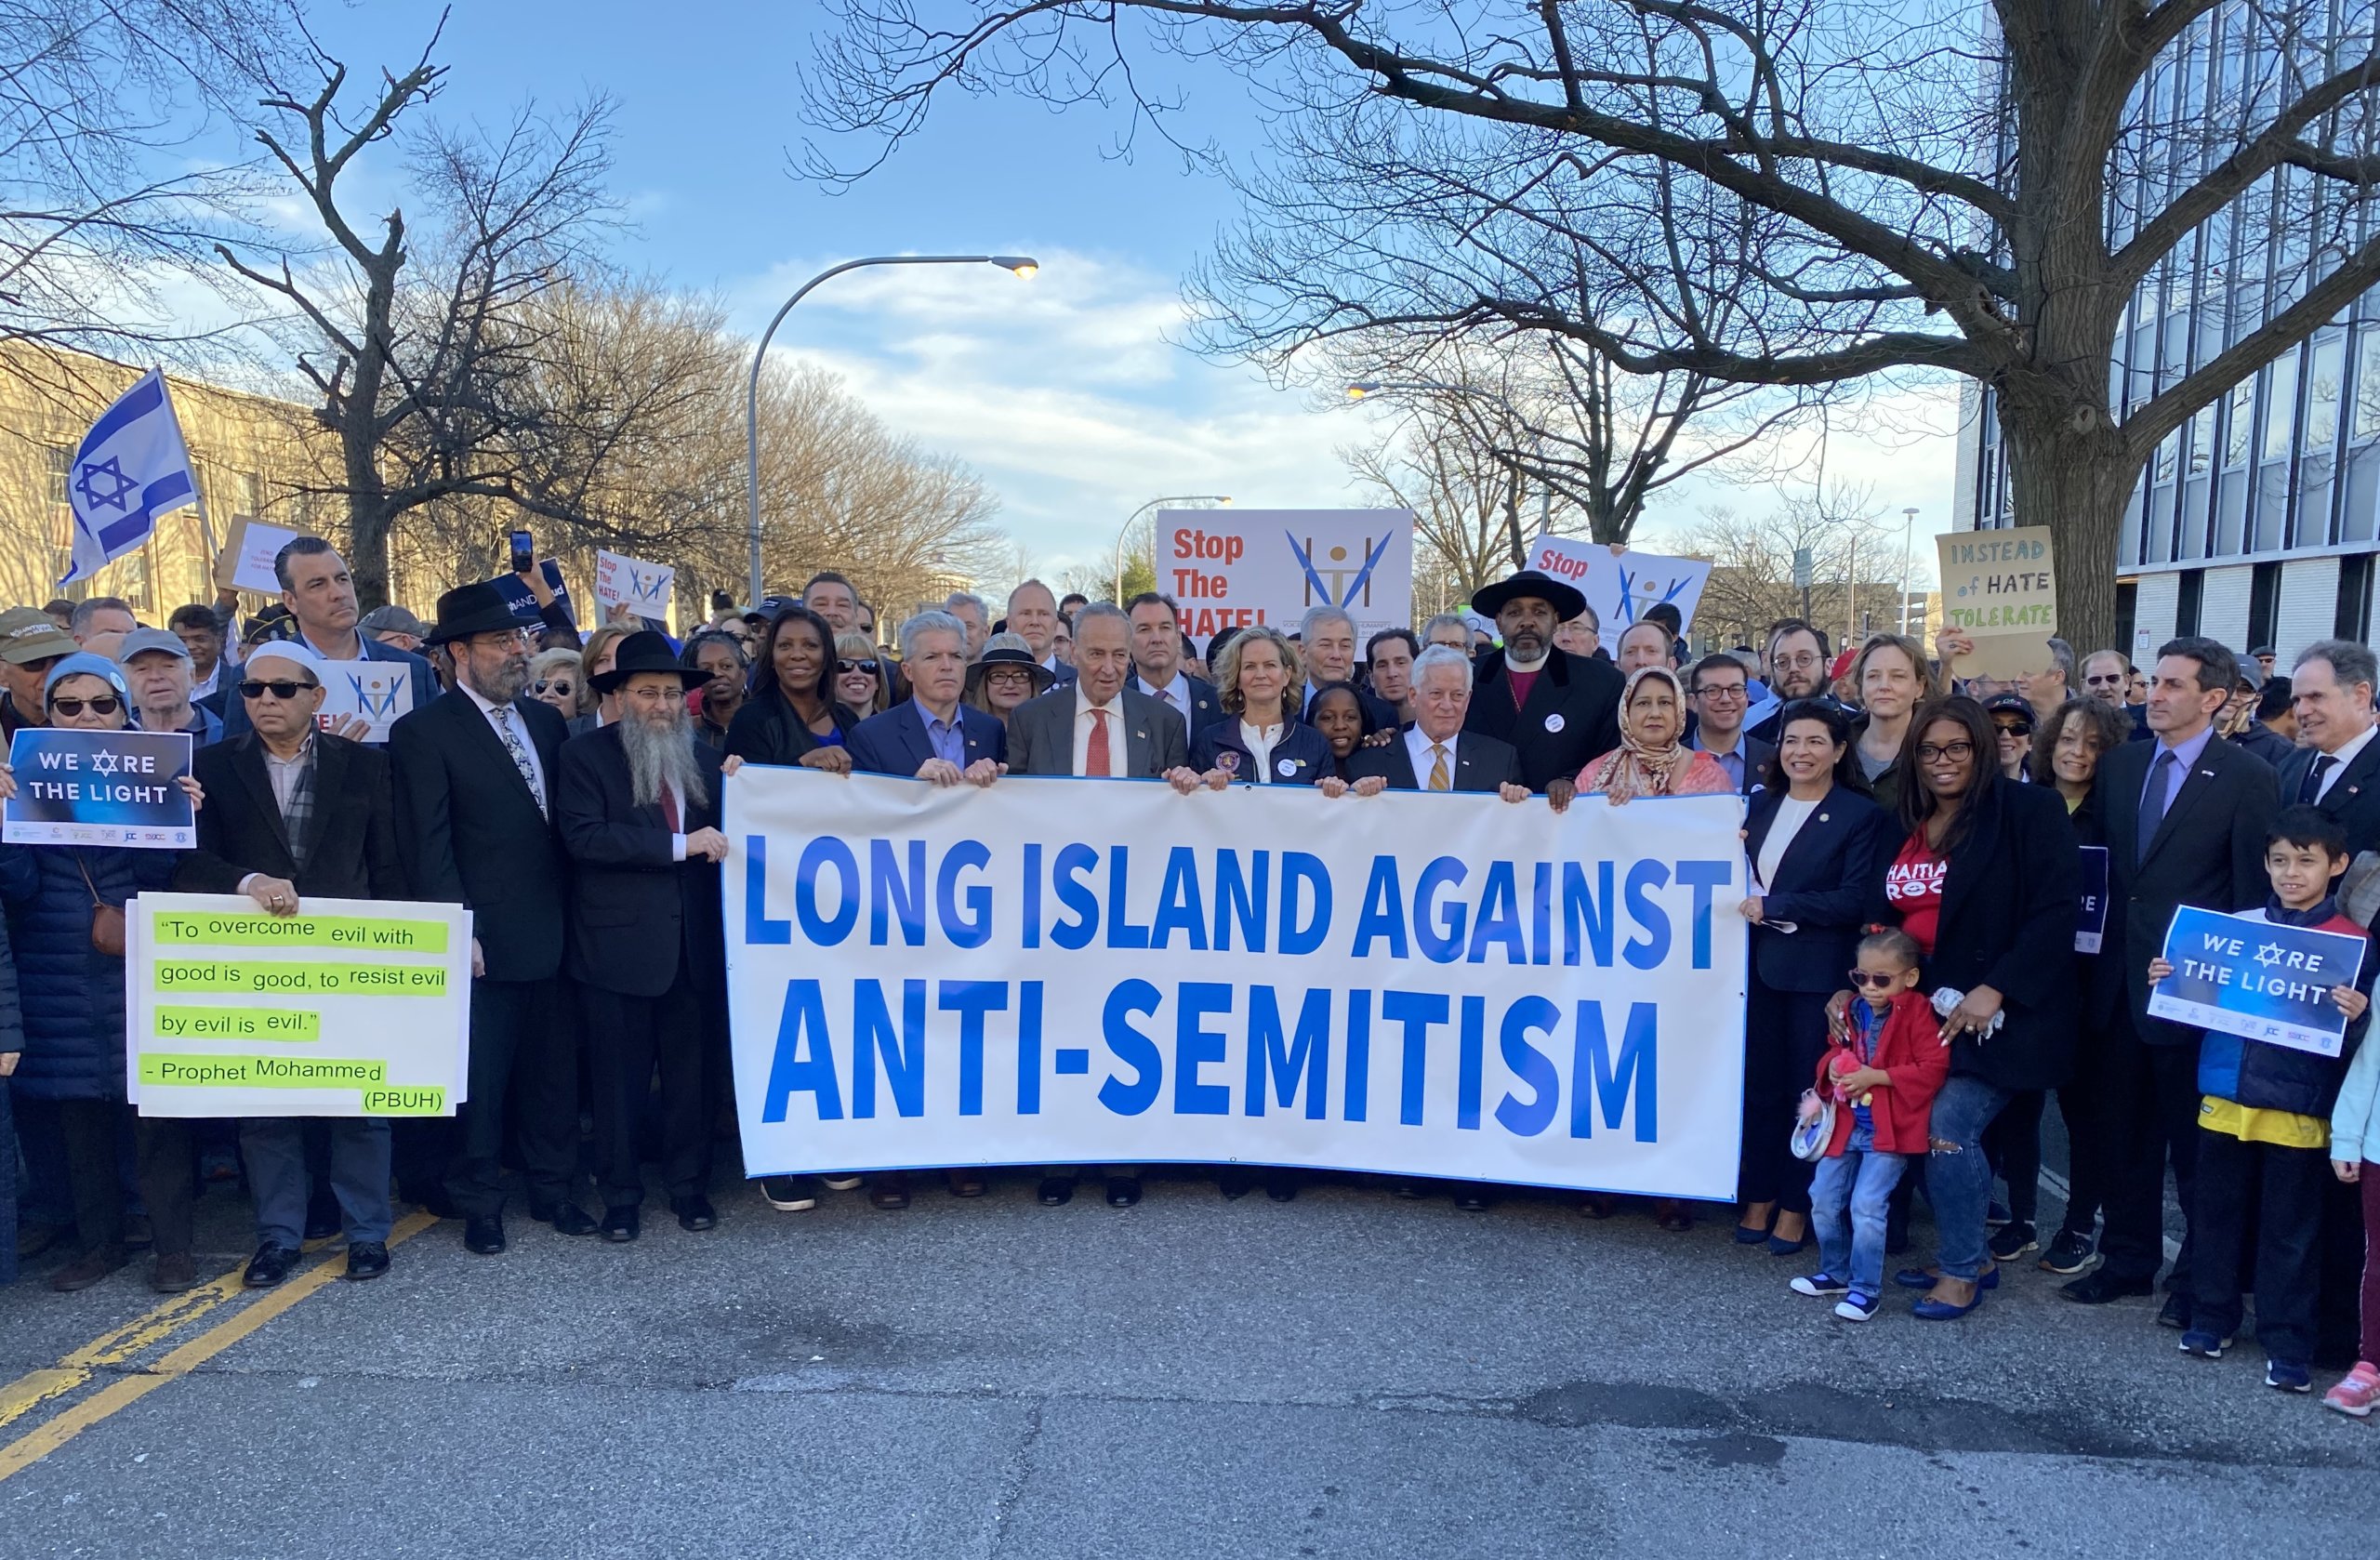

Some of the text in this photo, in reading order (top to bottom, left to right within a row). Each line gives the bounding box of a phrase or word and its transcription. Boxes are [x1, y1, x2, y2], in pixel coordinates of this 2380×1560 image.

[1173, 529, 1244, 565] Stop
[1950, 540, 2044, 564] INSTEAD
[600, 557, 617, 573] Stop
[1538, 549, 1589, 581] Stop
[599, 570, 612, 585] The
[1172, 568, 1228, 599] The
[1957, 572, 2051, 597] of HATE
[599, 585, 620, 602] HATE!
[1950, 604, 2054, 628] TOLERATE
[38, 751, 79, 771] WE
[29, 781, 167, 804] THE LIGHT
[1886, 860, 1948, 881] HAITIA
[1885, 879, 1944, 901] ROC
[746, 835, 1731, 970] LONG ISLAND AGAINST
[208, 919, 316, 935] overcome
[331, 926, 365, 943] evil
[373, 929, 414, 945] with
[2203, 932, 2245, 957] WE
[161, 965, 445, 991] good is good, to resist evil
[2184, 959, 2327, 1005] THE LIGHT
[161, 1014, 188, 1035] by
[193, 1016, 231, 1033] evil
[238, 1016, 255, 1033] is
[161, 1063, 247, 1084] Prophet
[256, 1060, 382, 1081] Mohammed
[761, 978, 1658, 1144] ANTI-SEMITISM
[364, 1091, 443, 1112] (PBUH)
